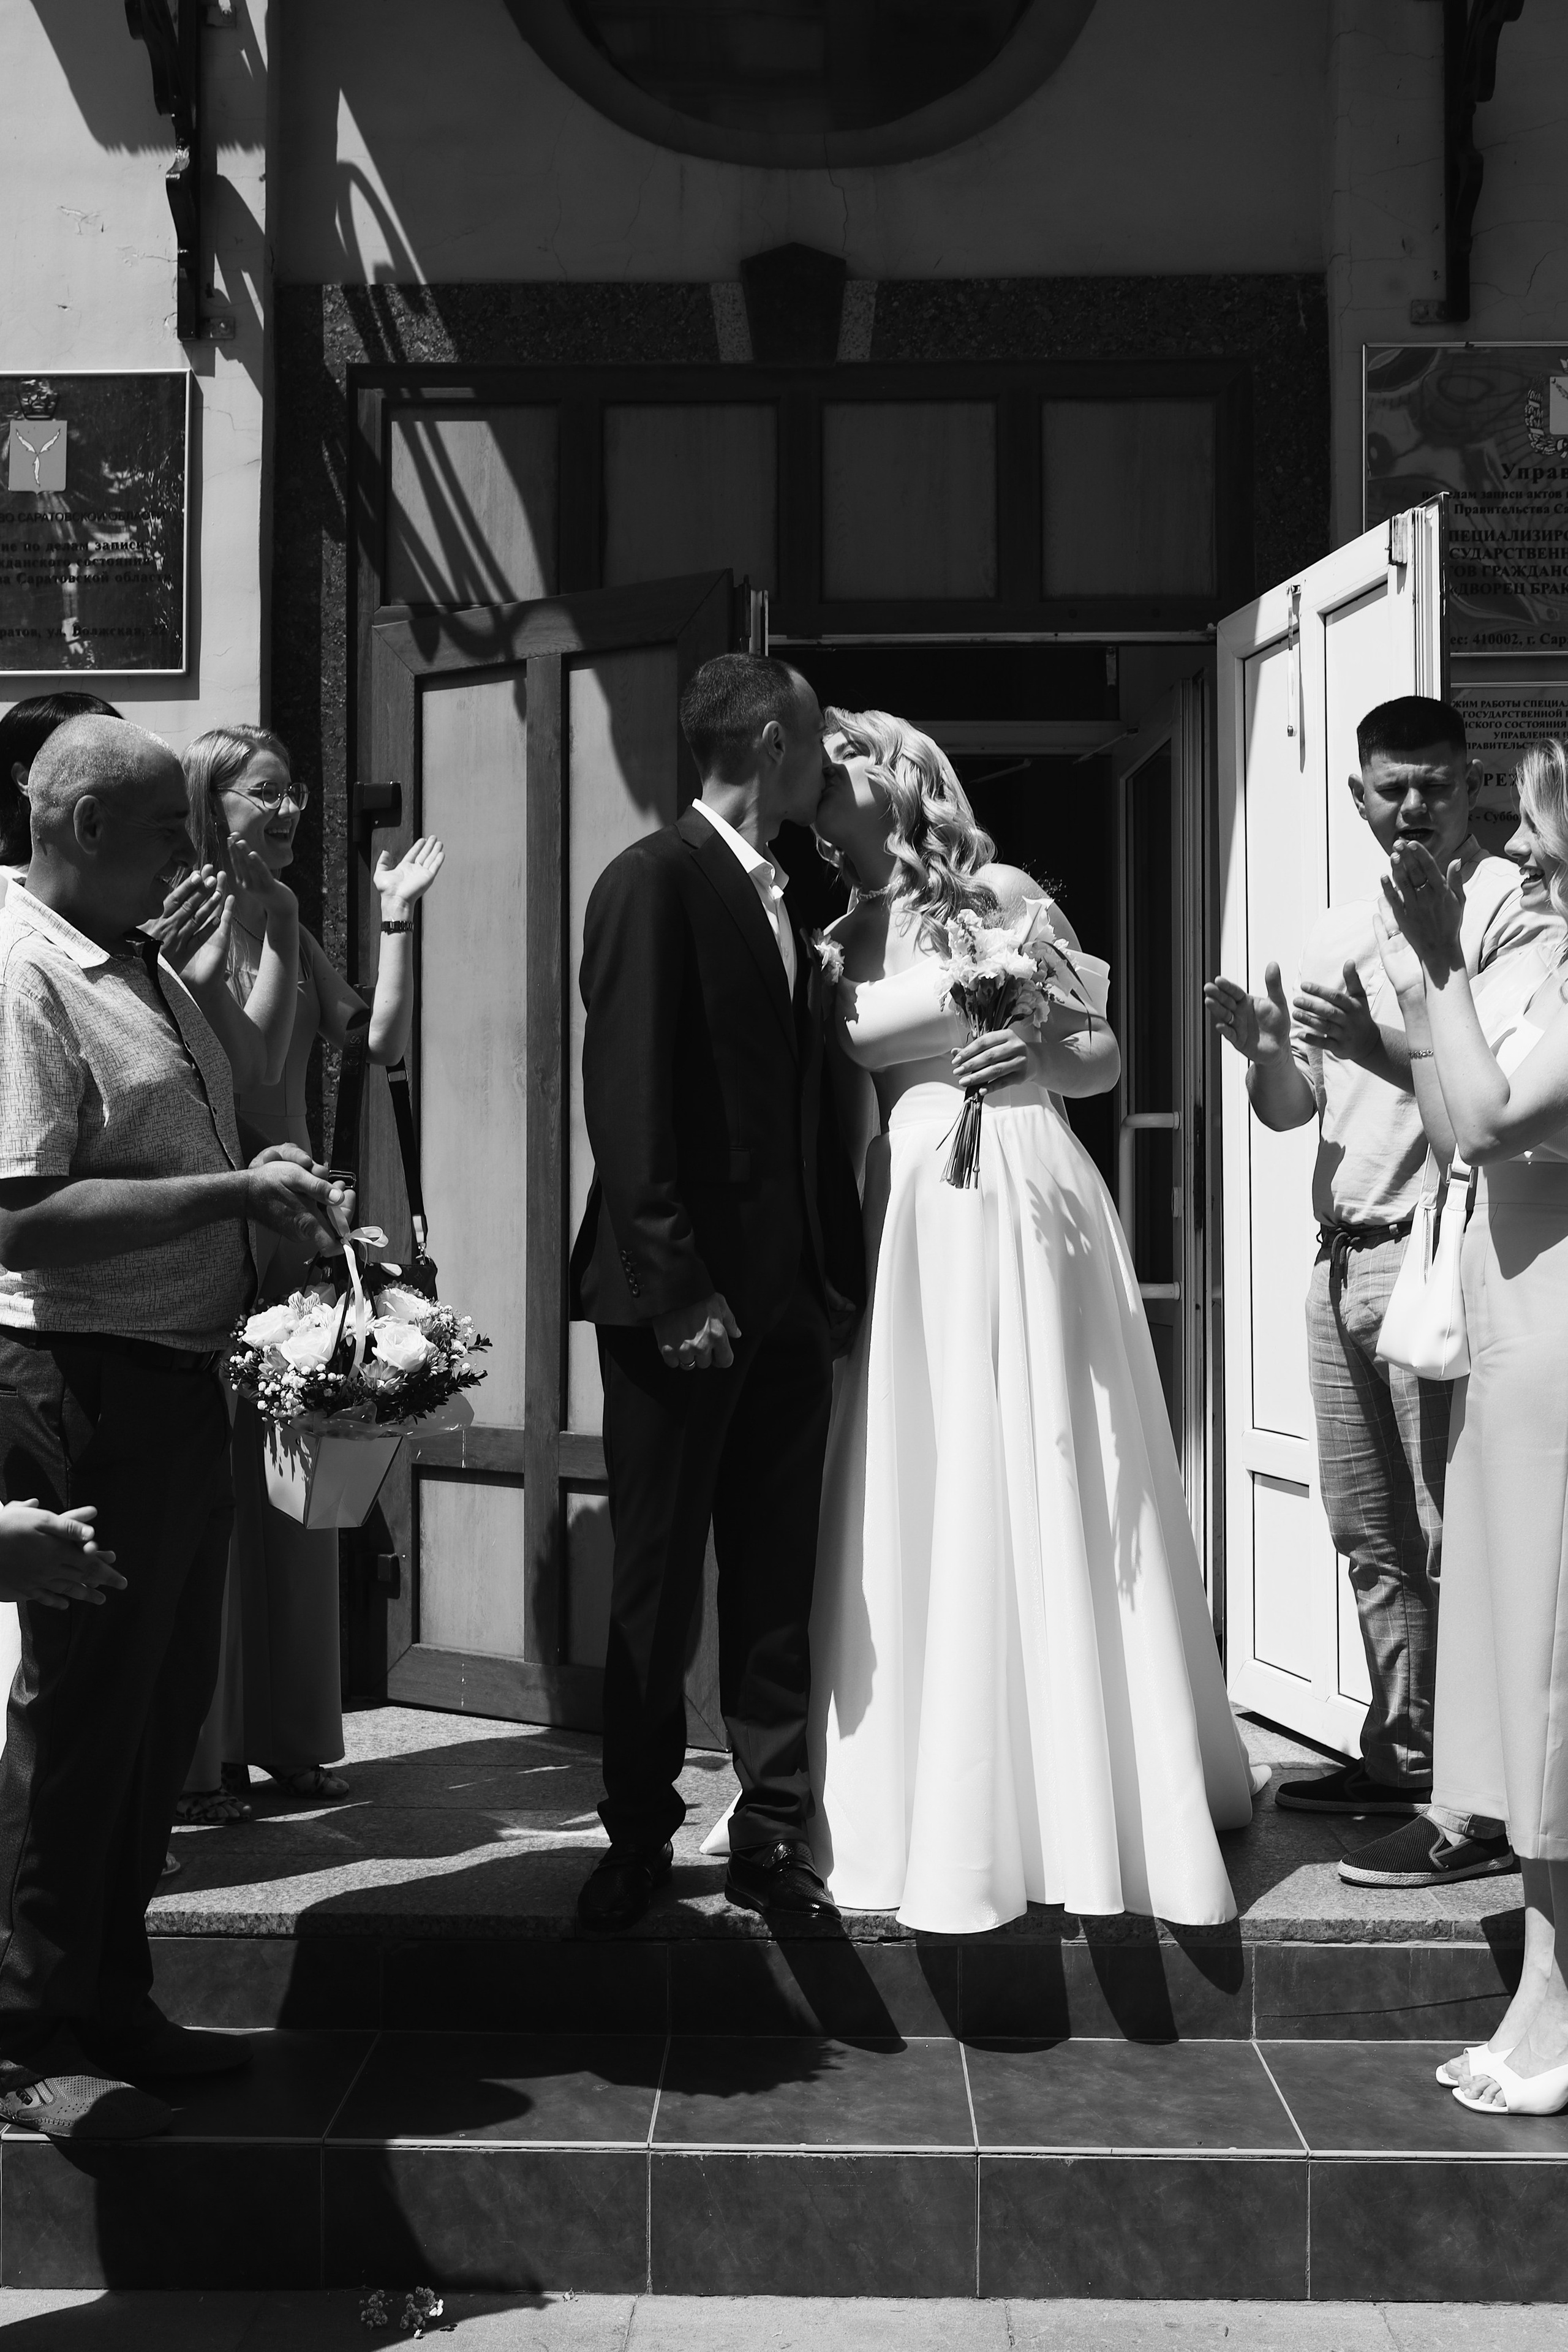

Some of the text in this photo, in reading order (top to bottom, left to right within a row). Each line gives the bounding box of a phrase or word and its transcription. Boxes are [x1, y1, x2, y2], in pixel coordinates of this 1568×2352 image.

[1501, 463, 1568, 484] Управ
[1526, 490, 1562, 499] актов
[1454, 503, 1568, 516] Правительства Са
[18, 511, 105, 522] САРАТОВСКОЙ
[109, 511, 165, 521] ОБЛАСТИ
[24, 543, 40, 551] по
[46, 543, 88, 552] делам
[95, 541, 144, 550] записи
[77, 557, 151, 567] состояния
[17, 571, 109, 587] Саратовской
[115, 572, 172, 582] области
[1450, 583, 1526, 597] «ДВОРЕЦ
[1472, 633, 1523, 646] 410002,
[1526, 636, 1536, 645] г.
[1540, 633, 1568, 647] Сар
[1463, 709, 1562, 719] ГОСУДАРСТВЕННОЙ
[1504, 720, 1567, 729] СОСТОЯНИЯ
[1494, 731, 1560, 739] УПРАВЛЕНИЯ
